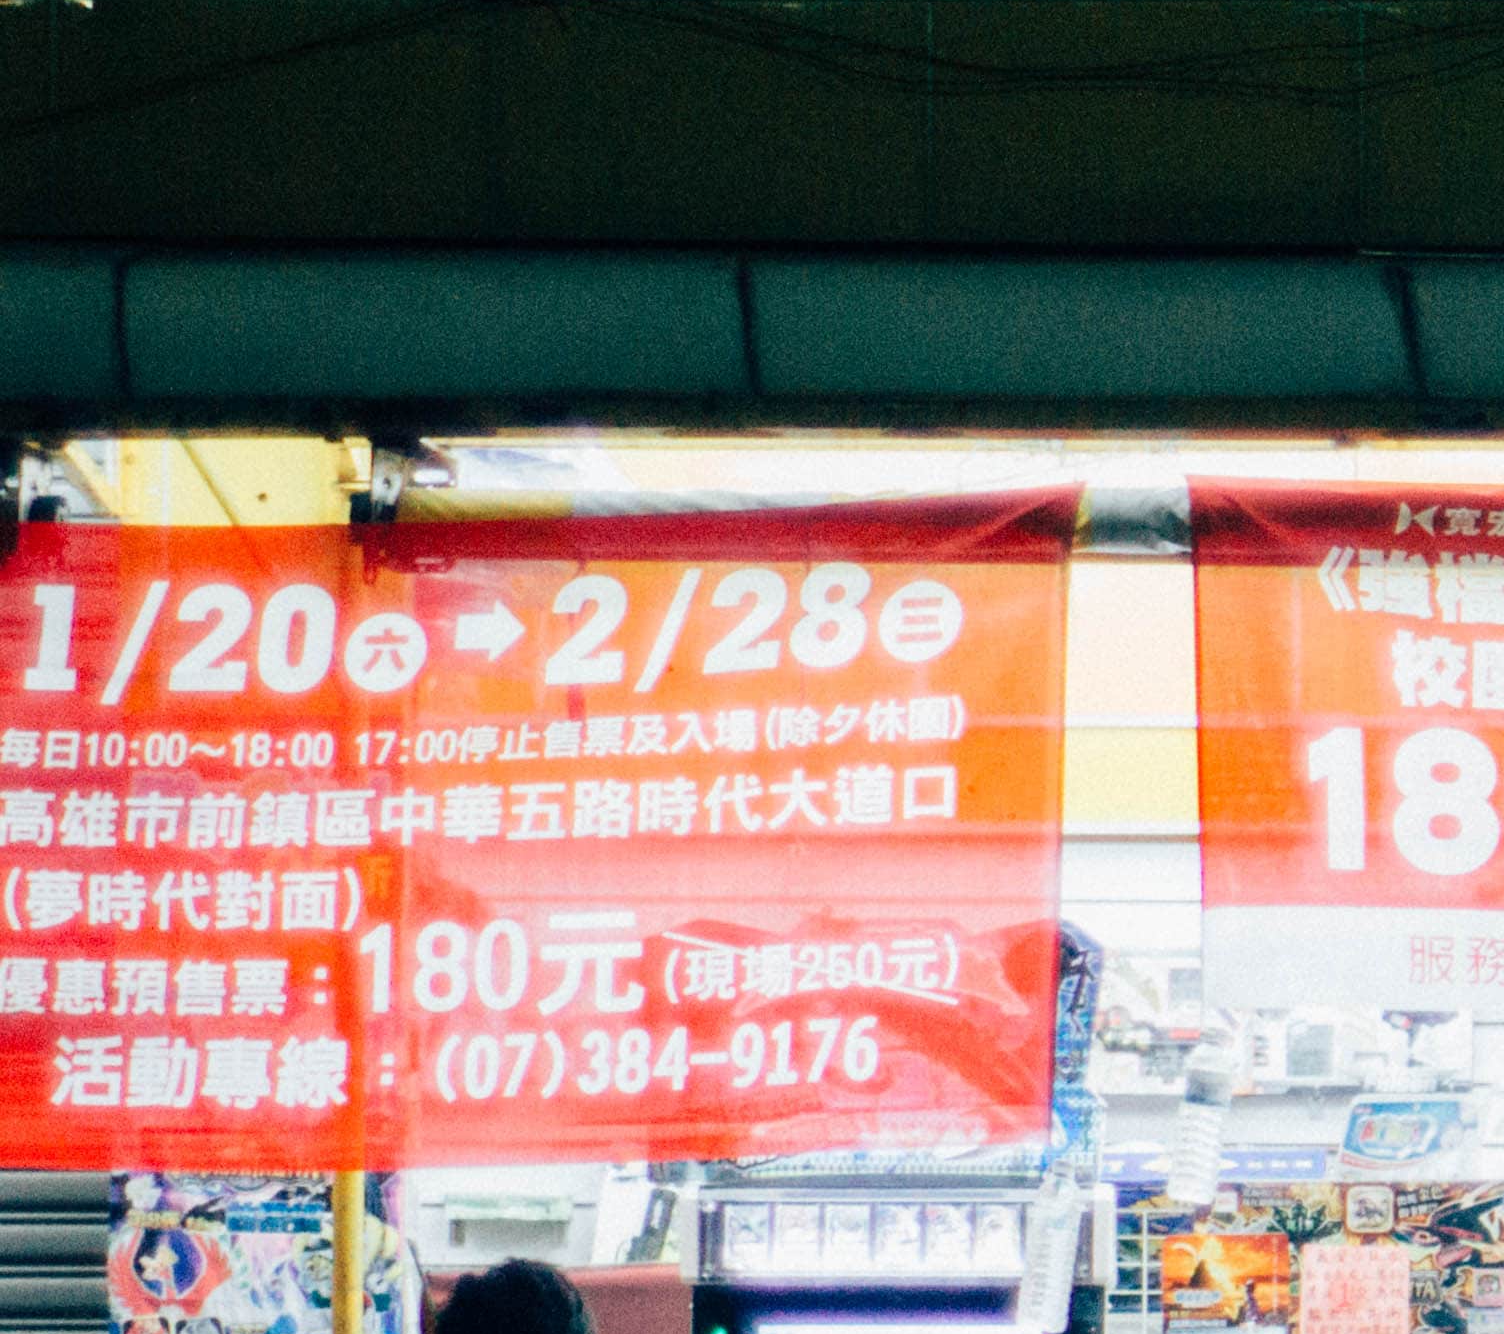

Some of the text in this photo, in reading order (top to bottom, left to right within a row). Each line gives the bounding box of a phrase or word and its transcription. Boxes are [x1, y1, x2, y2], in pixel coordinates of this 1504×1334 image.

[4, 867, 361, 933] (夢時代對面)
[358, 908, 647, 1017] 180元
